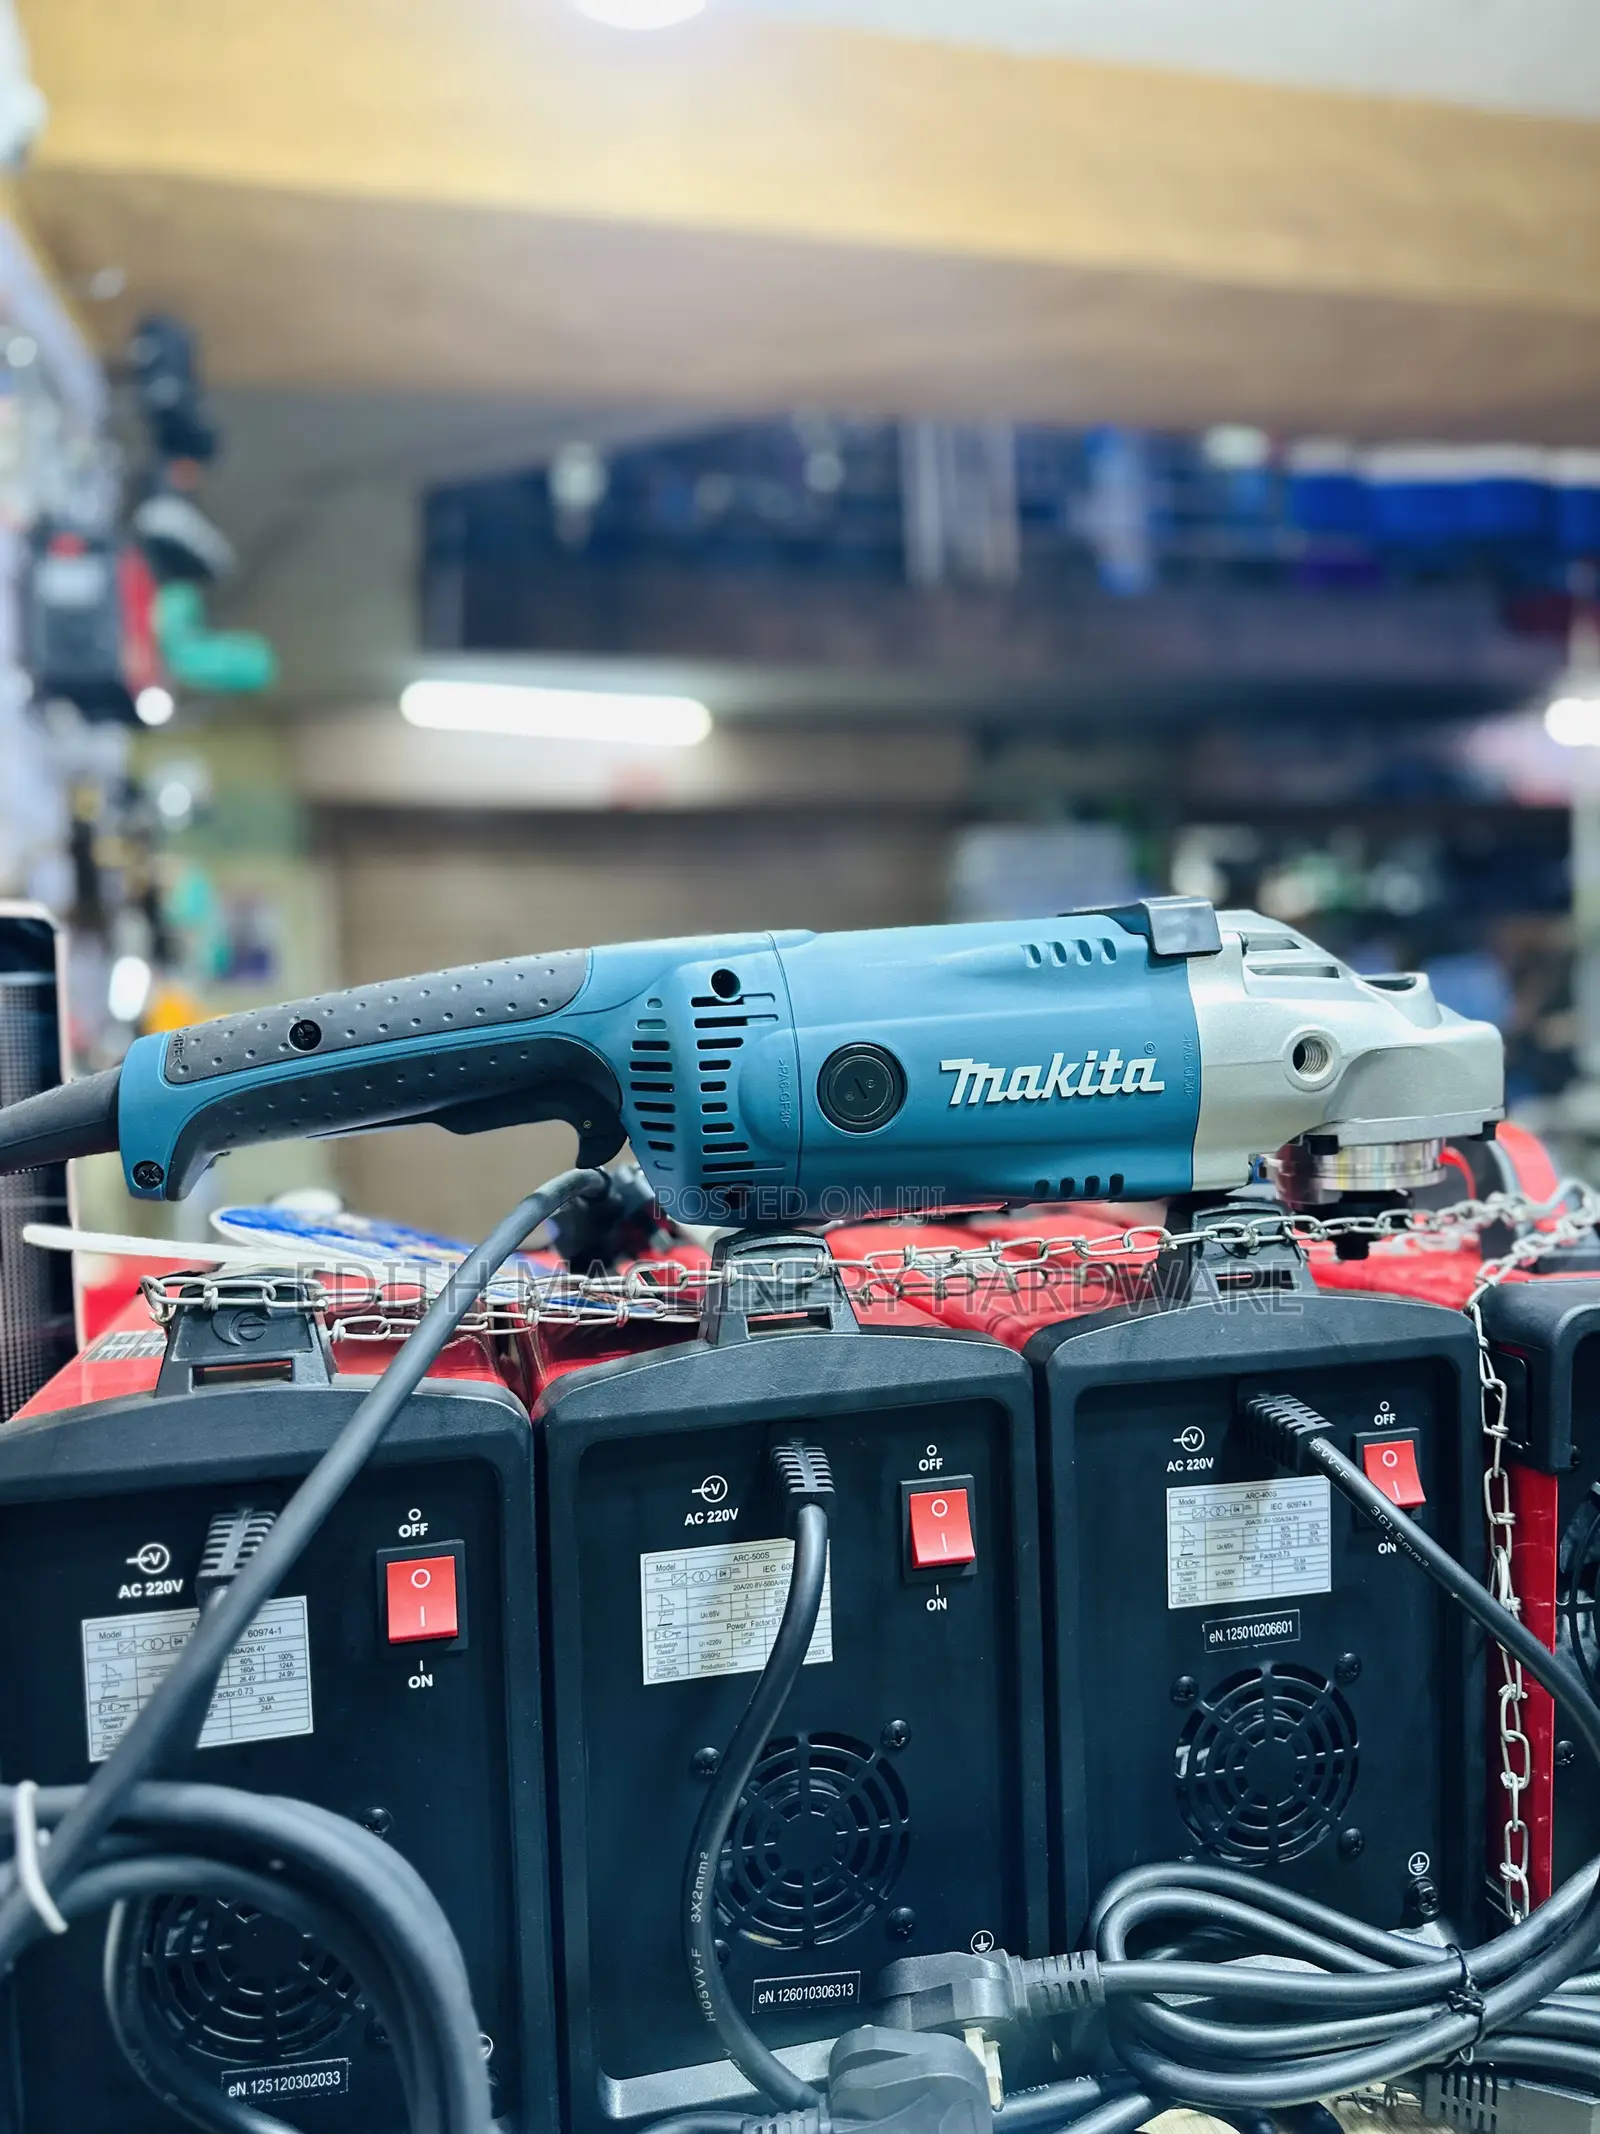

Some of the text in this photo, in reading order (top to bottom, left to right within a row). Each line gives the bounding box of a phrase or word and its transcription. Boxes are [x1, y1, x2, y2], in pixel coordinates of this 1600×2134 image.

[1373, 1412, 1397, 1426] OFF
[918, 1457, 944, 1472] OFF
[1166, 1456, 1215, 1473] AC 220V
[1178, 1497, 1197, 1506] Model
[1270, 1502, 1283, 1511] IEC
[684, 1507, 739, 1527] AC 220V
[398, 1522, 429, 1538] OFF
[1377, 1541, 1398, 1555] ON
[732, 1551, 770, 1563] ARC-500S
[655, 1562, 676, 1572] Model
[762, 1564, 777, 1573] IEC
[118, 1579, 184, 1599] AC 220V
[926, 1597, 947, 1612] ON
[247, 1626, 282, 1638] 60974-1
[726, 1622, 747, 1631] Power
[1209, 1620, 1293, 1643] eN.125010206601
[98, 1630, 122, 1640] Model
[408, 1674, 434, 1689] ON
[690, 1948, 716, 2022] H05VV-F
[758, 1983, 854, 2004] eN.126010306313
[228, 2071, 341, 2098] eN.125120302033
